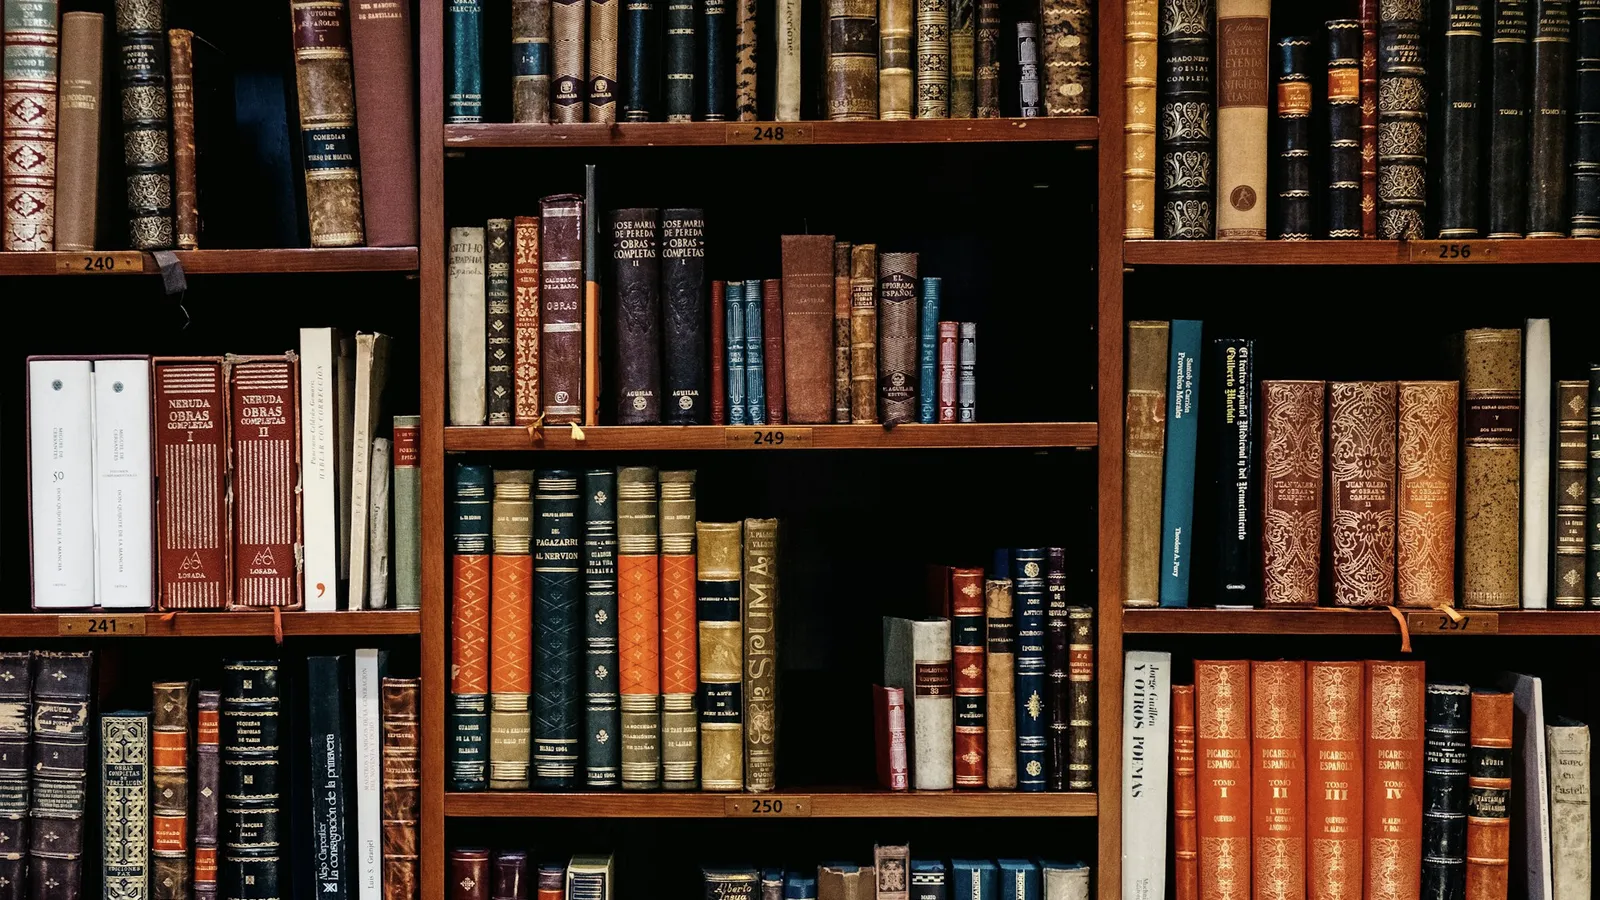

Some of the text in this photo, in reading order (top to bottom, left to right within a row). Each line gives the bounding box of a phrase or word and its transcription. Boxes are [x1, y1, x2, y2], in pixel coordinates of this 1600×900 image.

[1166, 55, 1193, 63] AMADO
[313, 133, 346, 141] COMEDIAS
[753, 126, 784, 141] 248
[613, 220, 656, 230] JOSE MARIA
[662, 219, 705, 229] JOSE MARIA
[615, 229, 654, 239] DE PEREDA
[664, 228, 703, 238] DE PEREDA
[620, 239, 649, 249] OBRAS
[669, 238, 697, 248] OBRAS
[613, 249, 656, 258] COMPLETAS
[662, 248, 705, 257] COMPLETAS
[1439, 244, 1471, 258] 256
[84, 257, 115, 270] 240
[882, 281, 915, 289] EPIGRAMA
[882, 288, 914, 297] ESPAÑOL
[546, 301, 577, 311] OBRAS
[1237, 359, 1248, 384] teatro
[1175, 352, 1186, 419] Proverbios Morales
[1184, 357, 1194, 414] Santob de Carrión
[168, 398, 210, 409] NERUDA
[242, 395, 283, 404] NERUDA
[1236, 386, 1248, 417] español
[168, 410, 210, 421] OBRAS
[242, 406, 282, 417] OBRAS
[167, 420, 213, 430] COMPLETAS
[240, 416, 286, 425] COMPLETAS
[314, 364, 326, 480] HABLAR CON CORRECCIÓN
[187, 431, 193, 442] I
[258, 427, 269, 437] II
[753, 430, 785, 445] 249
[1236, 420, 1248, 459] Medieval
[1237, 467, 1248, 480] del
[1293, 480, 1318, 489] VALERA
[1364, 481, 1388, 489] VALERA
[1424, 481, 1451, 489] VALERA
[1236, 481, 1248, 541] Renacimiento
[536, 538, 578, 546] PAGAZARRI
[1174, 527, 1182, 553] Theodore
[535, 551, 579, 560] AL NERVION
[1174, 553, 1180, 561] A.
[88, 618, 117, 633] 241
[1148, 664, 1160, 727] Jorge Guillén
[1131, 664, 1146, 798] Y OTROS POEMAS
[52, 751, 59, 759] 2
[1206, 749, 1241, 758] PICARESCA
[1262, 749, 1297, 758] PICARESCA
[1319, 751, 1354, 760] PICARESCA
[1378, 750, 1412, 759] PICARESCA
[1206, 759, 1241, 769] ESPAÑOLA
[1263, 759, 1297, 769] ESPAÑOLA
[1319, 761, 1353, 770] ESPAÑOLA
[1378, 759, 1412, 770] ESPAÑOLA
[1221, 787, 1228, 798] I
[1272, 787, 1288, 798] II
[1324, 789, 1348, 800] III
[1385, 788, 1404, 799] IV
[325, 733, 341, 881] La consagración de la primavera
[752, 799, 783, 813] 250
[1213, 815, 1236, 823] QUEVEDO
[318, 822, 328, 881] Alejo Carpentier
[366, 839, 375, 864] Granjel
[367, 875, 375, 889] Luis
[714, 884, 752, 894] Alberto
